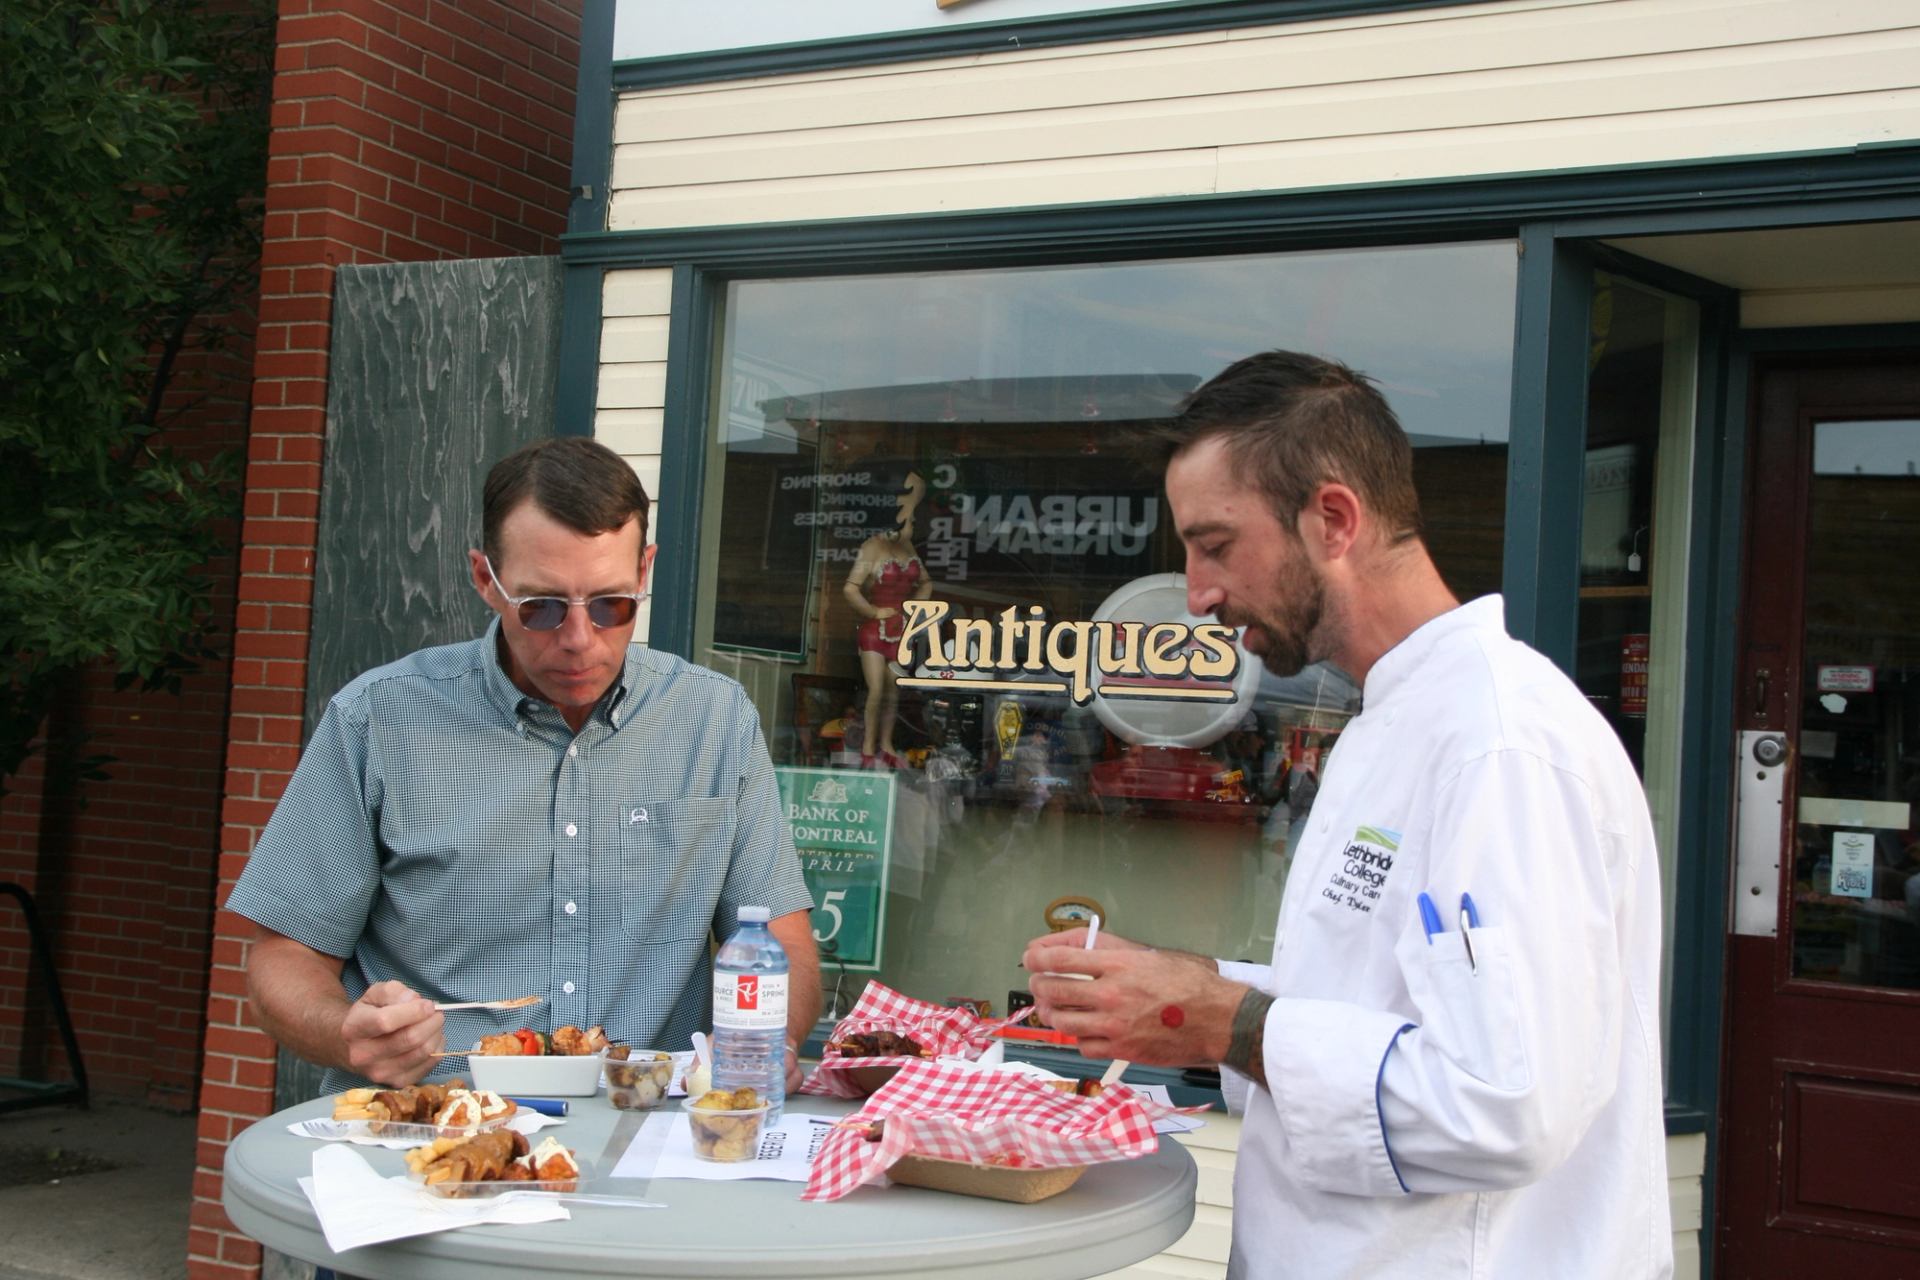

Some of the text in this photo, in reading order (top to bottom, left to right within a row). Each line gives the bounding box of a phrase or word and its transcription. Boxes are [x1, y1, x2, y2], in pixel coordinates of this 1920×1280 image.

[897, 599, 1239, 706] Antiques
[787, 803, 869, 824] BANK OF
[812, 889, 848, 943] 5
[762, 988, 785, 998] SPRING
[757, 1131, 787, 1160] RESERVED
